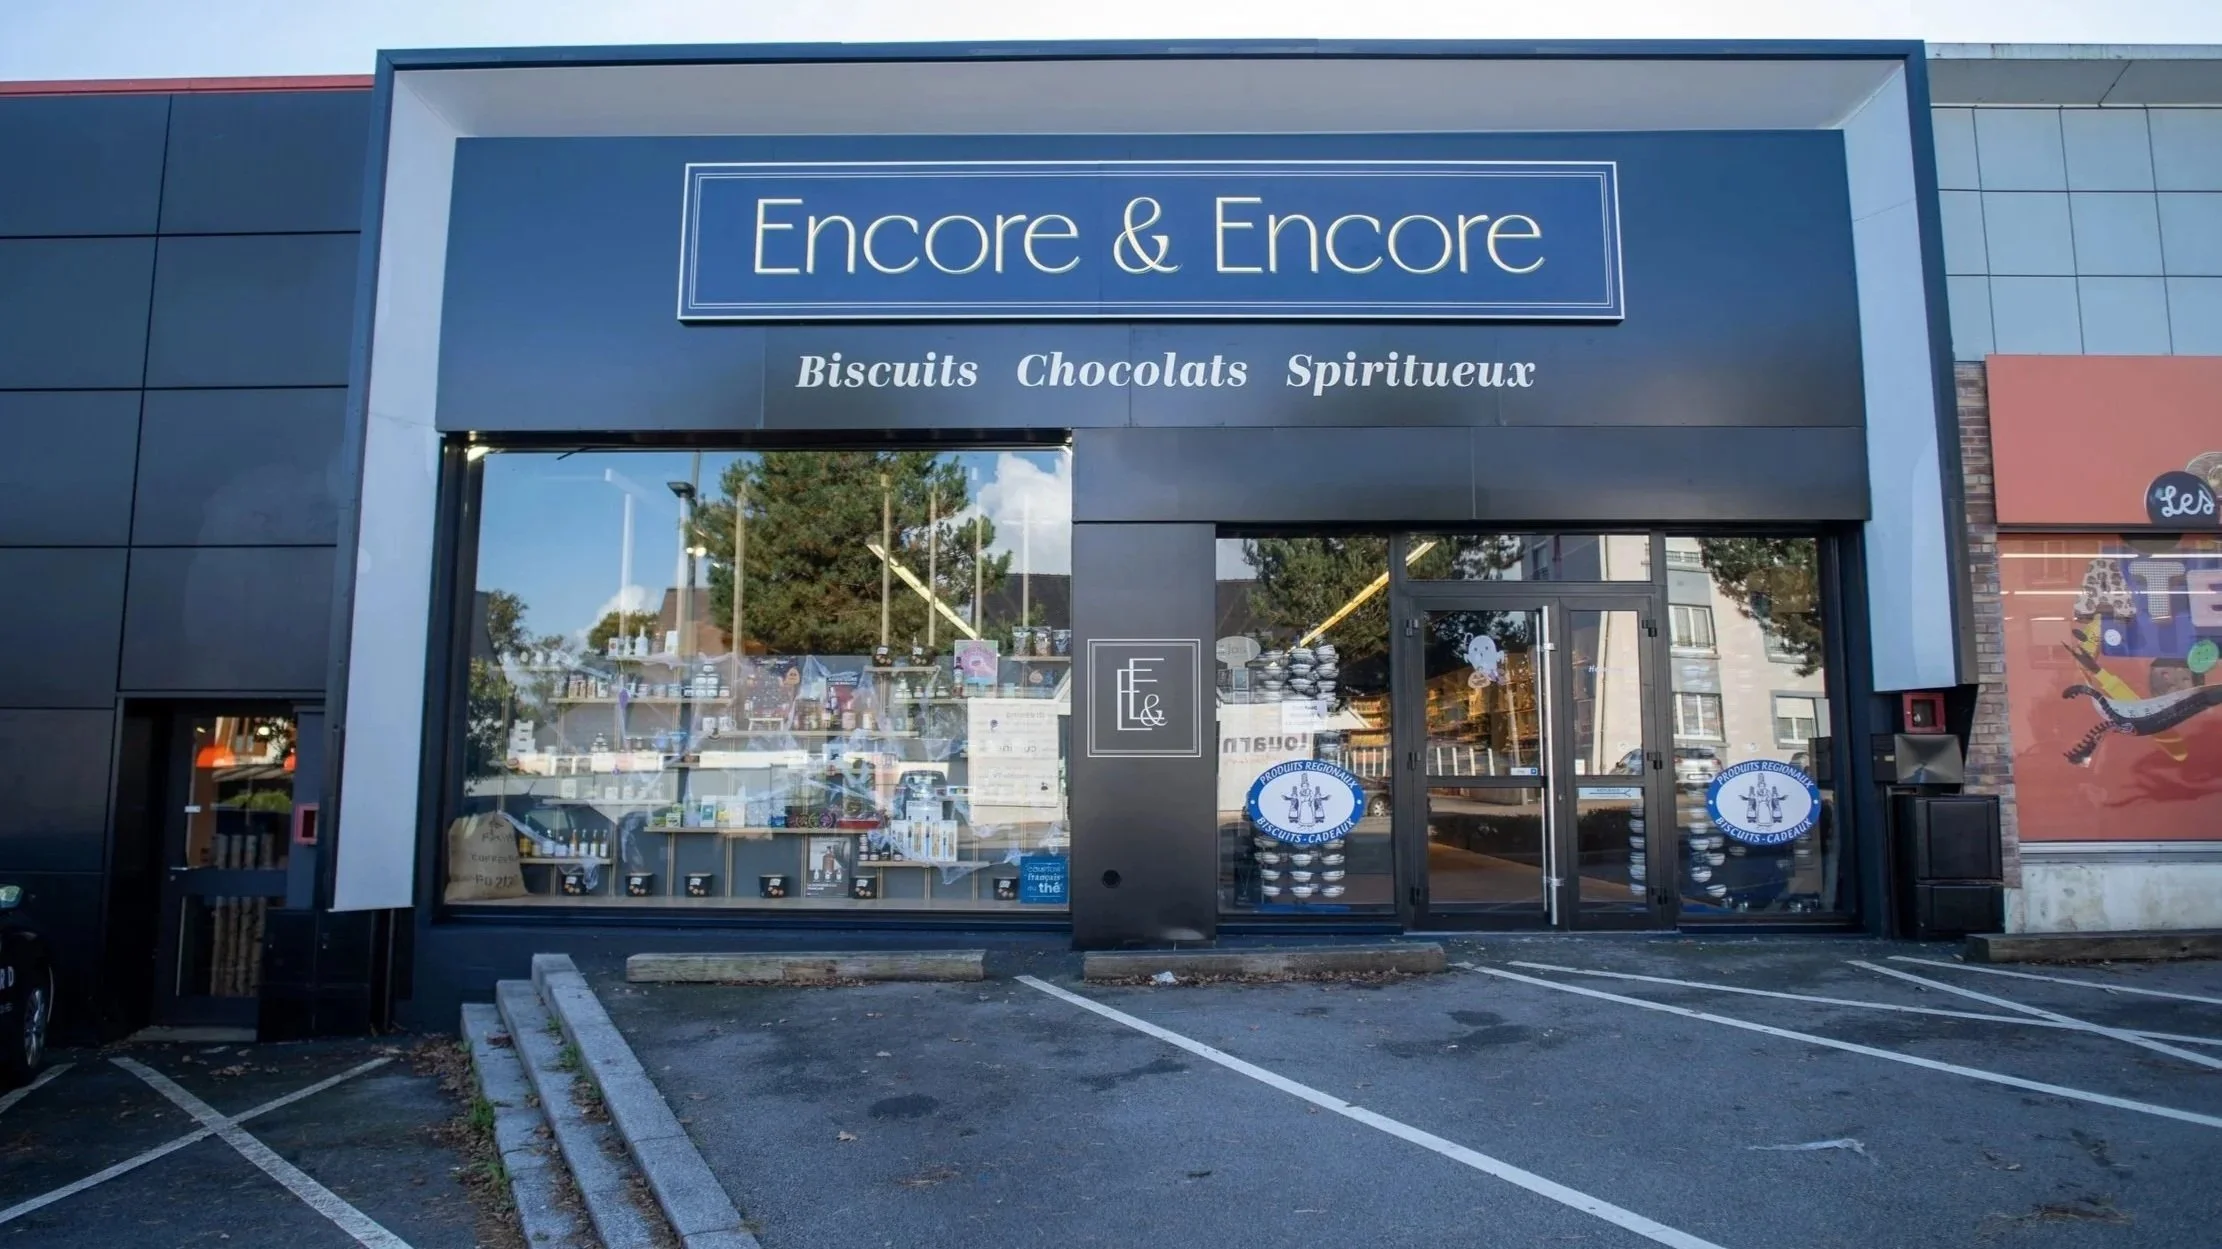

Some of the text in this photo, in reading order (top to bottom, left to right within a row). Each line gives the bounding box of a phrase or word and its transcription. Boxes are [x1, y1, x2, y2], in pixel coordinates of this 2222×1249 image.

[754, 196, 1546, 275] Encore & Encore
[795, 351, 1536, 396] Biscuits Chocolats Spiritueux
[2159, 484, 2215, 518] Les
[1260, 761, 1358, 789] PRODUITS REGIONAUX
[1716, 761, 1815, 789] PRODUITS REGIONAUX
[1257, 817, 1303, 843] BISCUITS
[1309, 817, 1355, 843] CADEAUX
[1715, 816, 1760, 843] BISCUITS
[1767, 817, 1813, 843] CADEAUX
[1038, 881, 1061, 893] thé
